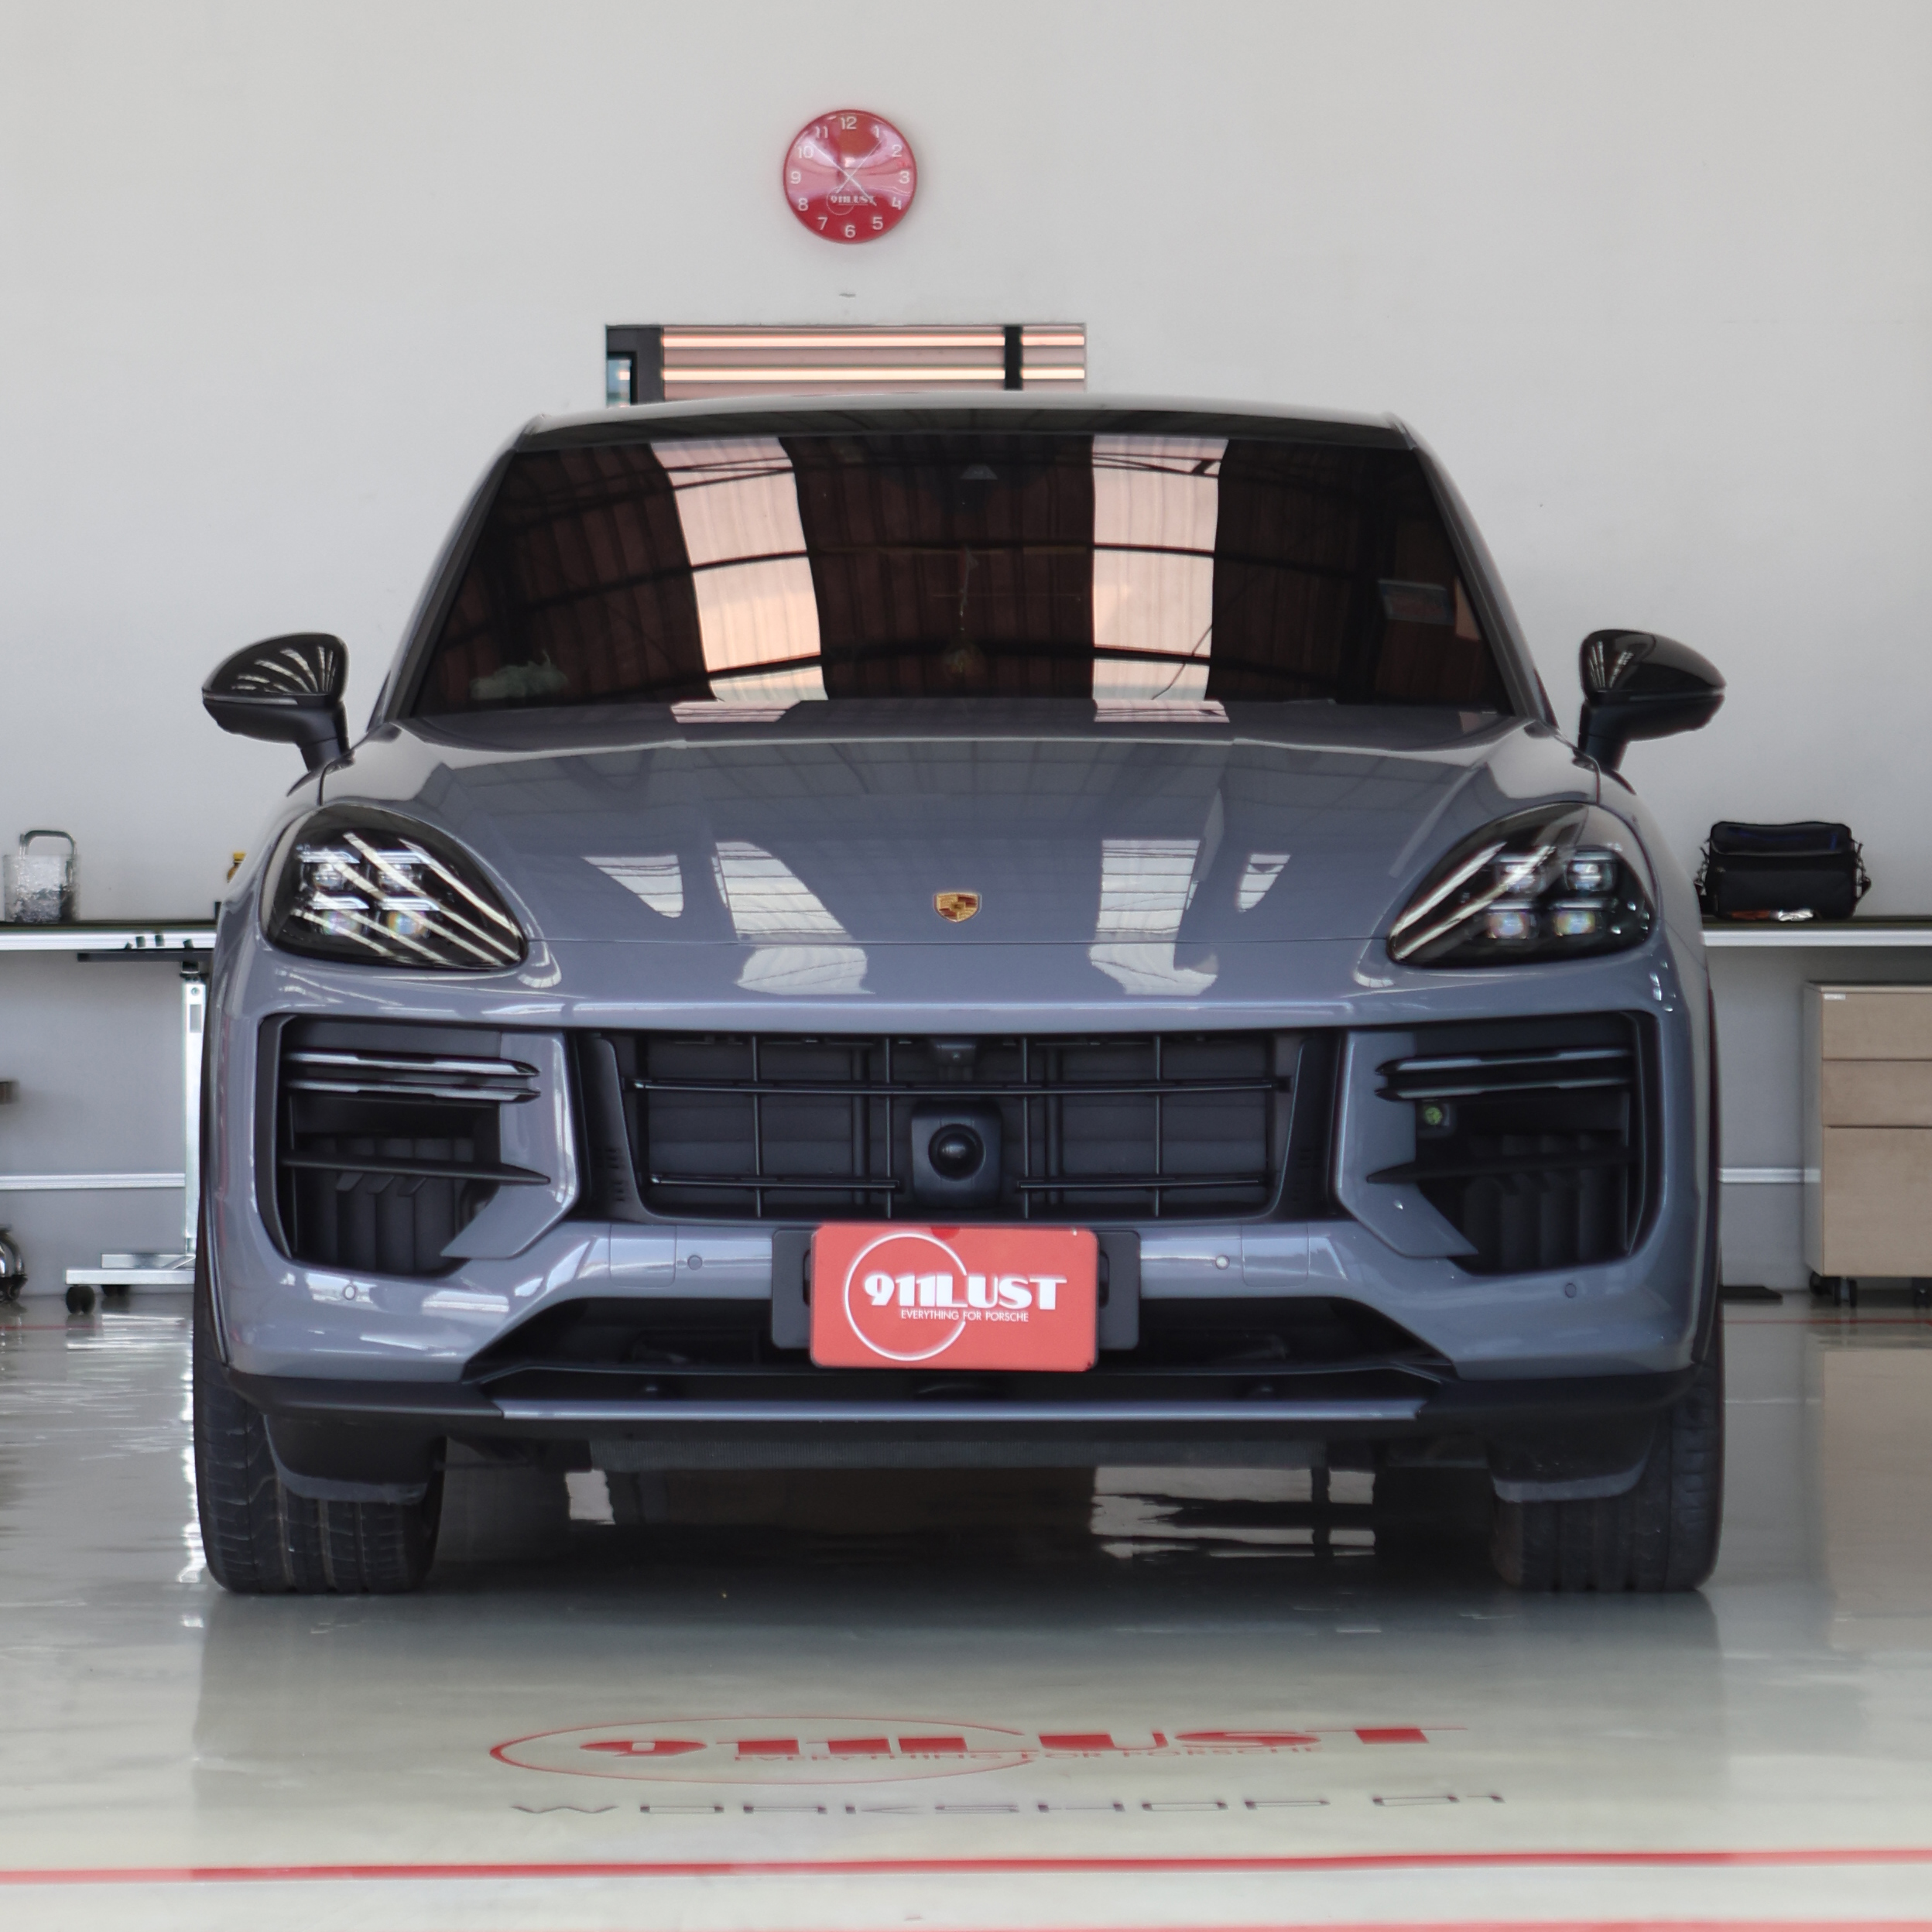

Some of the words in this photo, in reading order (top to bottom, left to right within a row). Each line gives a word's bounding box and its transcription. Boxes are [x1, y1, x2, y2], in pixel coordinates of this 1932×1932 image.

[841, 117, 857, 130] 12
[815, 126, 828, 139] 11
[873, 125, 880, 138] 1
[797, 146, 814, 159] 10
[891, 145, 903, 157] 2
[790, 171, 801, 184] 9
[899, 171, 910, 183] 3
[798, 198, 809, 211] 8
[892, 197, 902, 211] 4
[817, 217, 827, 231] 7
[872, 217, 883, 231] 5
[844, 225, 856, 238] 6
[864, 1274, 1067, 1310] 911LUST
[901, 1309, 959, 1321] EVERYTHING
[963, 1310, 982, 1321] FOR
[985, 1311, 1029, 1322] PORSCHE
